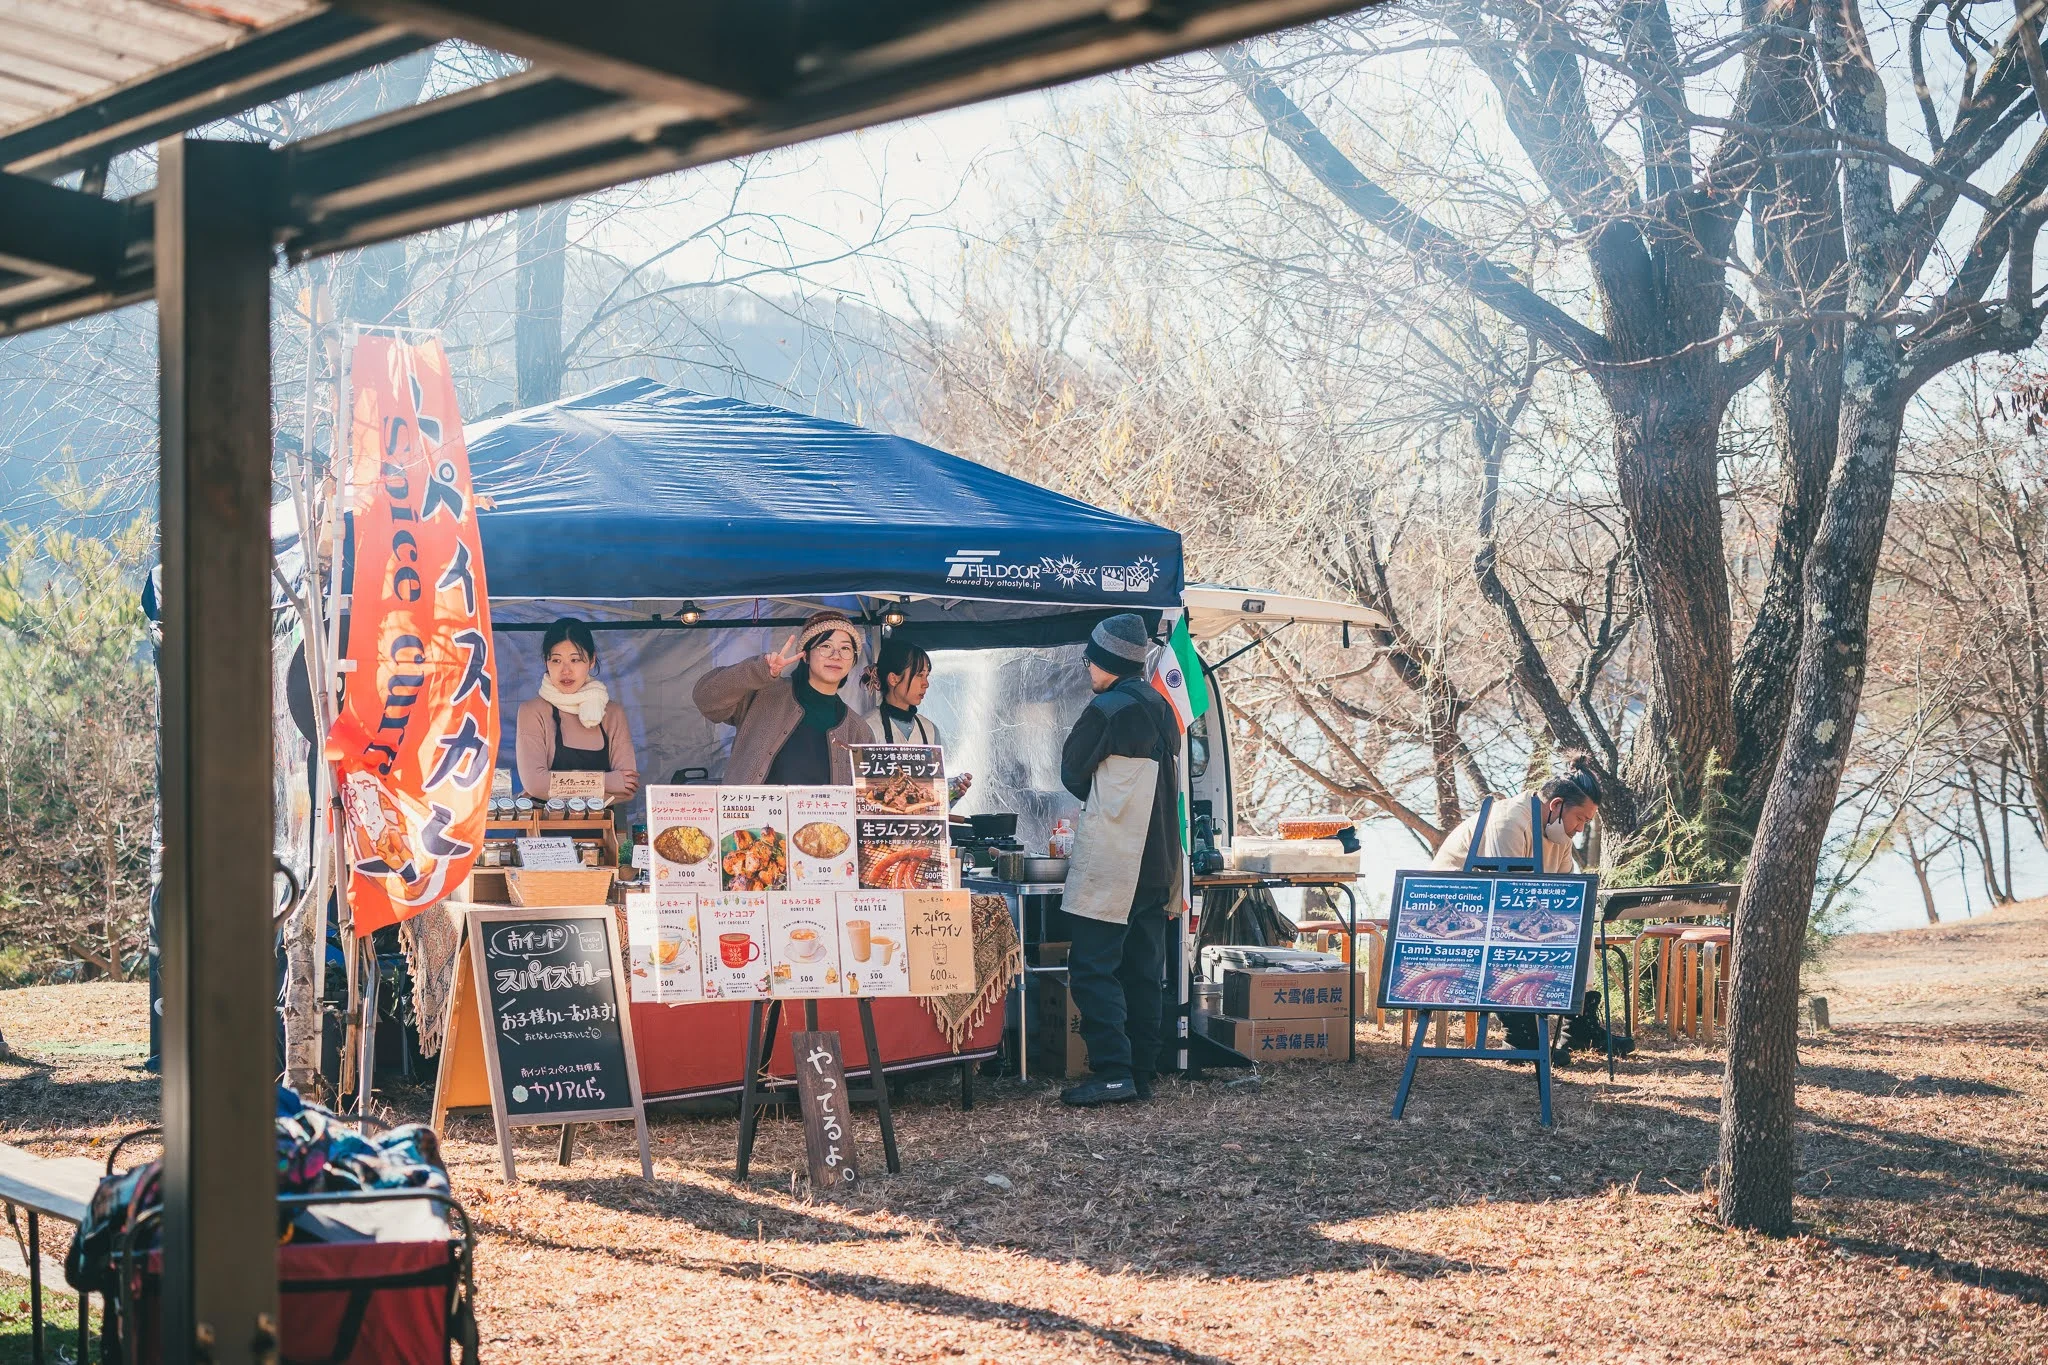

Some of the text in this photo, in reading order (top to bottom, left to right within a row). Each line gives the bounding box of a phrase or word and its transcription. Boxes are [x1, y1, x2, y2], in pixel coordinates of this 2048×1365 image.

[967, 563, 1041, 580] FIELDOOR
[945, 577, 1041, 590] Powered by ottostyle.jp
[1128, 577, 1142, 587] UV
[363, 415, 425, 776] Spice Curr
[870, 753, 926, 761] クミン香る炭火焼き
[858, 761, 941, 777] ラムチョップ
[721, 794, 783, 802] タンドリーチキン
[796, 800, 848, 809] ポテトキーマ
[857, 804, 883, 812] 1300円
[768, 808, 782, 816] 500
[862, 821, 943, 837] 生ラムフランク
[678, 870, 696, 878] 1000
[1512, 887, 1567, 896] クミン香る炭火焼き
[854, 904, 887, 912] CHAI TEA
[1405, 900, 1484, 915] Lamb Chop
[1500, 895, 1580, 909] ラムチョップ
[714, 910, 756, 919] ホットココア
[923, 910, 952, 922] スパイス
[911, 924, 962, 937] ホットワイン
[1491, 931, 1515, 939] 1300円
[507, 928, 564, 951] 南インド
[1401, 944, 1481, 958] Lamb Sausage
[1492, 948, 1572, 963] 生ラムフランク
[494, 960, 612, 994] スパイスカレー
[732, 972, 746, 980] 500
[800, 975, 814, 983] 500
[870, 972, 883, 980] 500
[660, 979, 674, 987] 500
[1273, 987, 1343, 1005] 大雪備長炭
[501, 1002, 617, 1031] お子様カレーあります!
[1261, 1033, 1329, 1051] 大雪備長炭
[806, 1046, 855, 1182] やってるよ。
